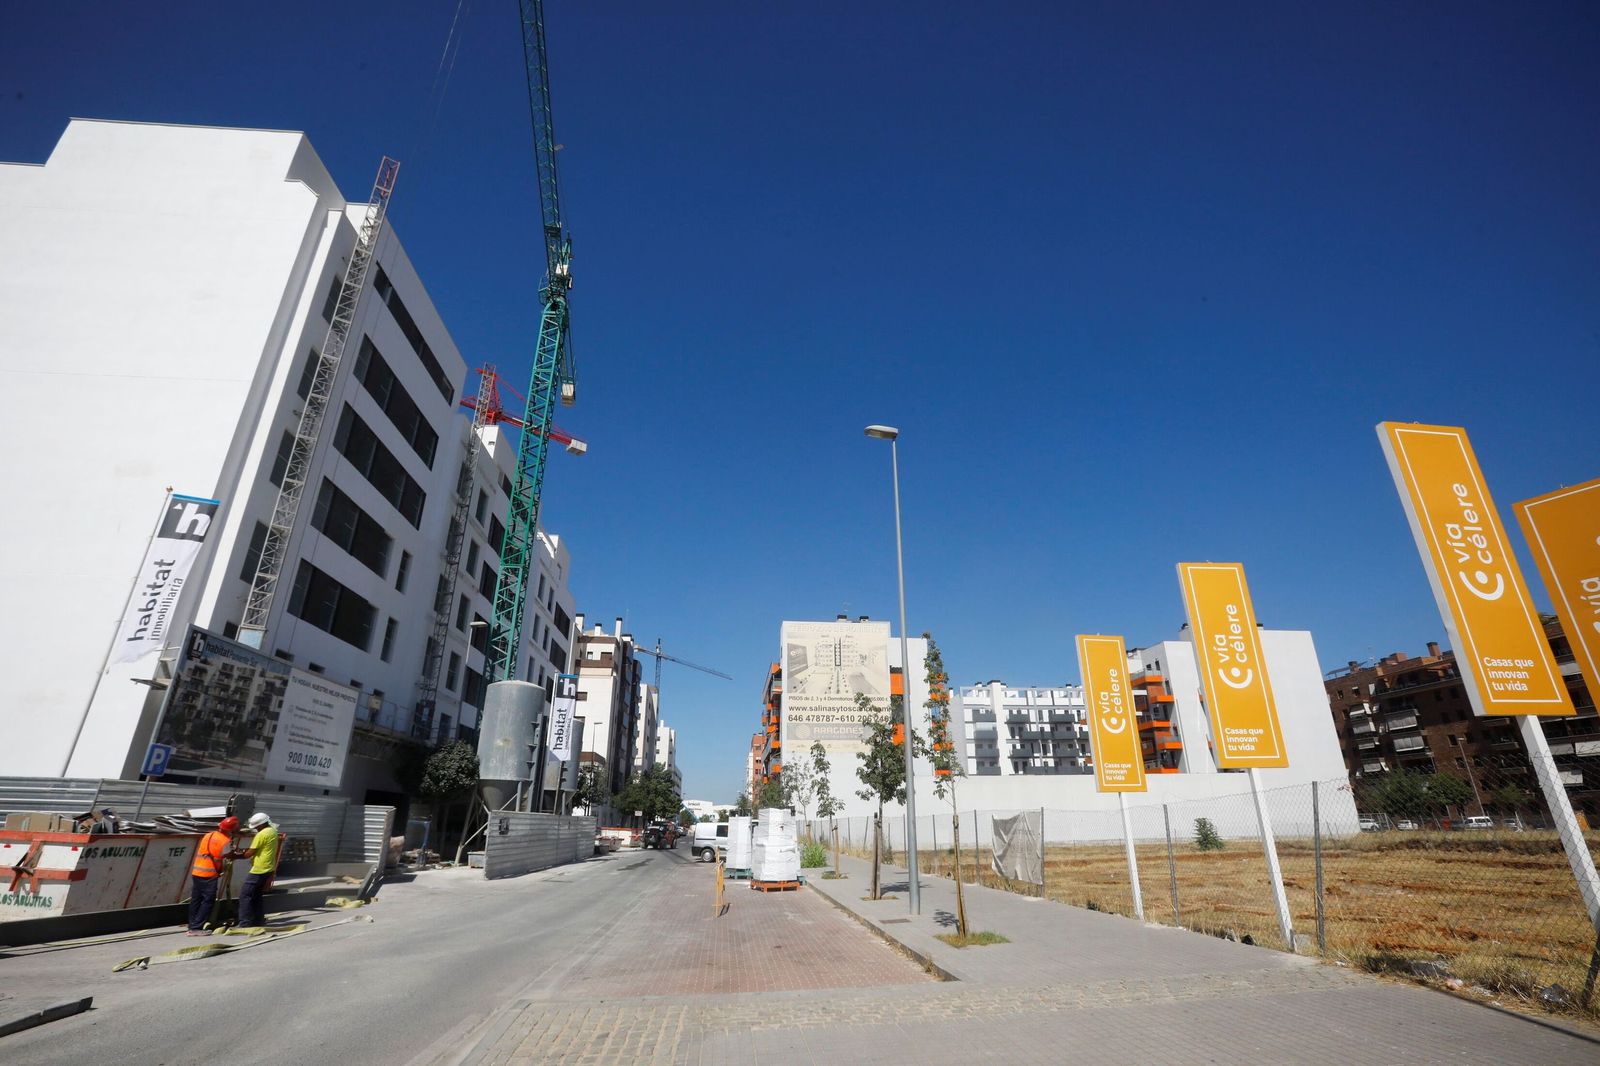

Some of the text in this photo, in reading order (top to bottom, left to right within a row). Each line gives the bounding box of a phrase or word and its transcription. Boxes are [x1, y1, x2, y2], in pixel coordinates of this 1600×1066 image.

[1453, 483, 1493, 564] célere
[1445, 523, 1470, 564] vía
[127, 559, 176, 642] habitat
[147, 577, 184, 641] inmobiliaria
[1226, 604, 1247, 663] célere
[206, 643, 230, 658] habitat
[1213, 634, 1230, 663] vía
[1483, 657, 1534, 670] Casas que
[1488, 669, 1529, 679] innovan
[1109, 668, 1123, 714] célere
[1492, 681, 1528, 691] tu vida
[1099, 691, 1111, 714] vía
[553, 708, 567, 750] habitat
[1248, 728, 1263, 736] que
[1238, 743, 1255, 751] vida
[148, 748, 166, 771] P
[288, 752, 332, 769] 900 100 420
[80, 847, 98, 858] LOS
